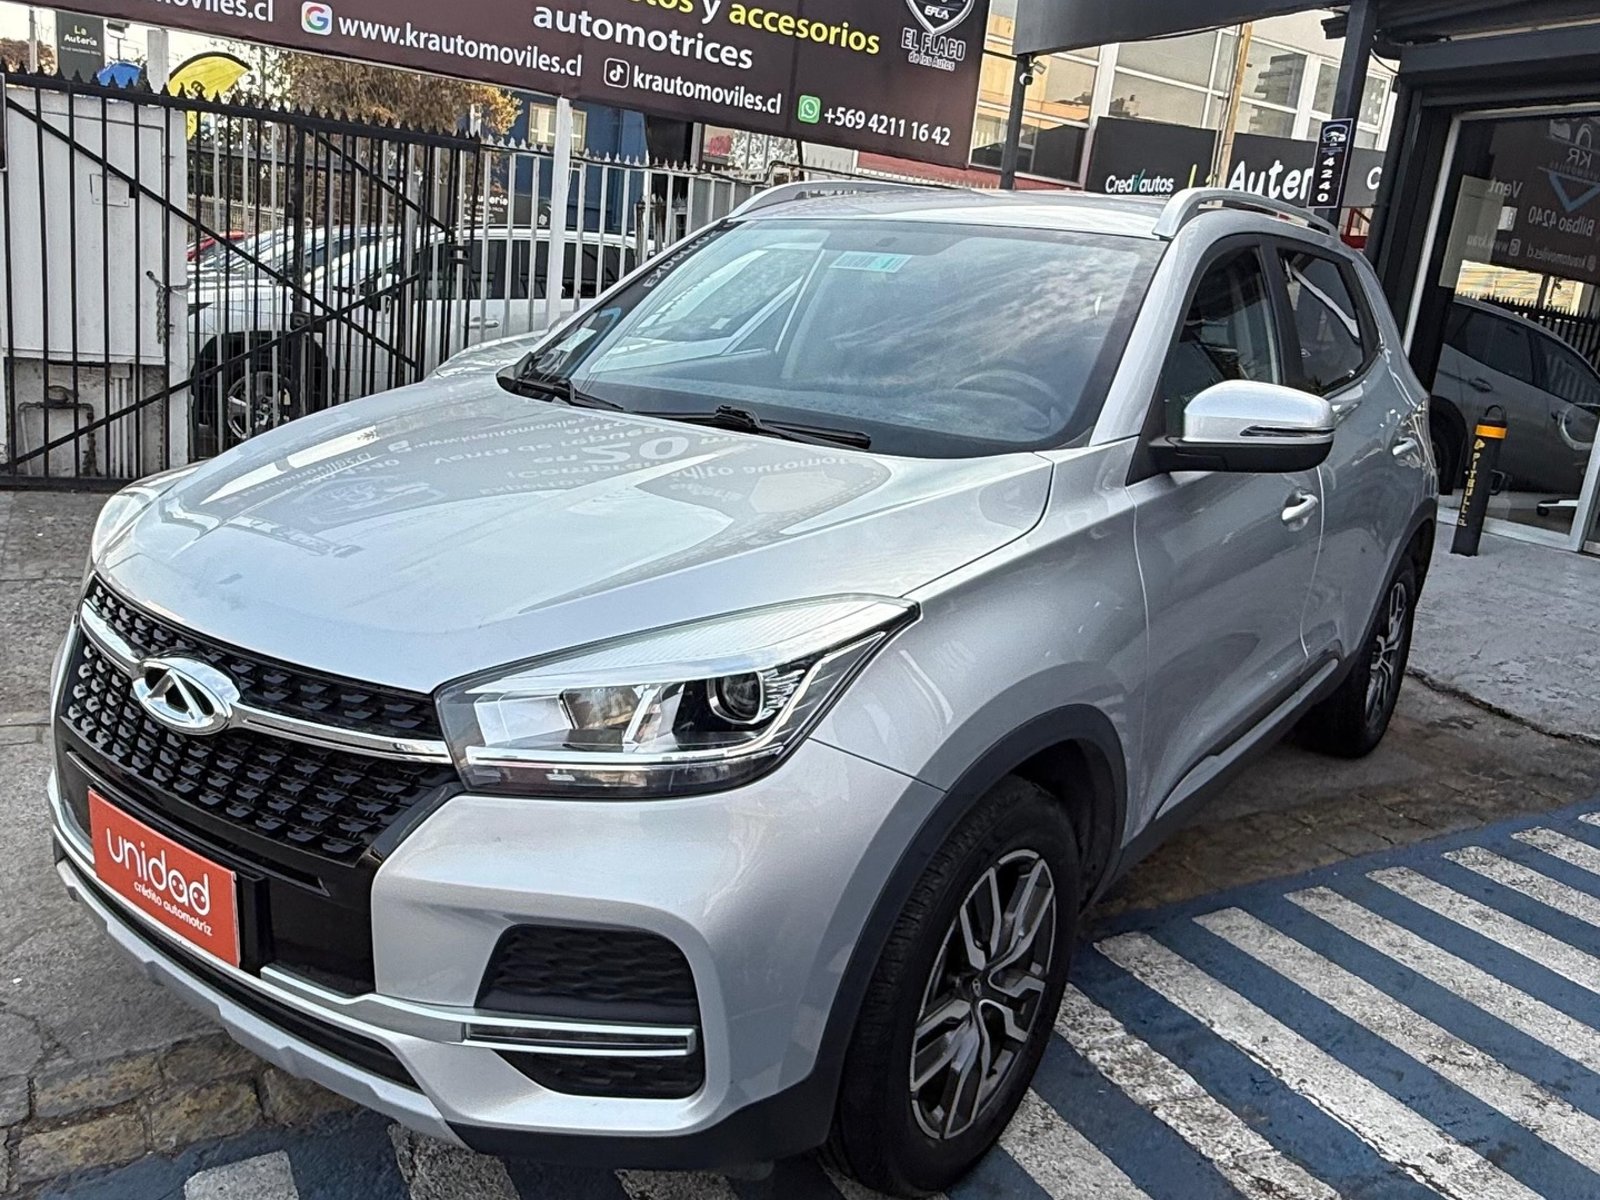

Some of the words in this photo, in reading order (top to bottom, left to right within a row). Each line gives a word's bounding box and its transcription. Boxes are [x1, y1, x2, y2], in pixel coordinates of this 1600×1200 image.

[73, 25, 88, 35] La
[150, 0, 273, 22] viles.cl
[701, 0, 721, 24] y
[728, 3, 880, 55] accesorios
[338, 16, 582, 77] www.krautomoviles.cl
[533, 6, 753, 69] automotrices
[901, 27, 920, 50] EL
[921, 32, 967, 61] FLACO
[633, 65, 782, 114] krautomoviles.cl
[824, 106, 866, 129] +569
[868, 113, 906, 138] 4211
[1316, 156, 1335, 202] 4240
[106, 828, 211, 916] unidad
[133, 881, 163, 907] crédito
[163, 900, 213, 937] automotriz
